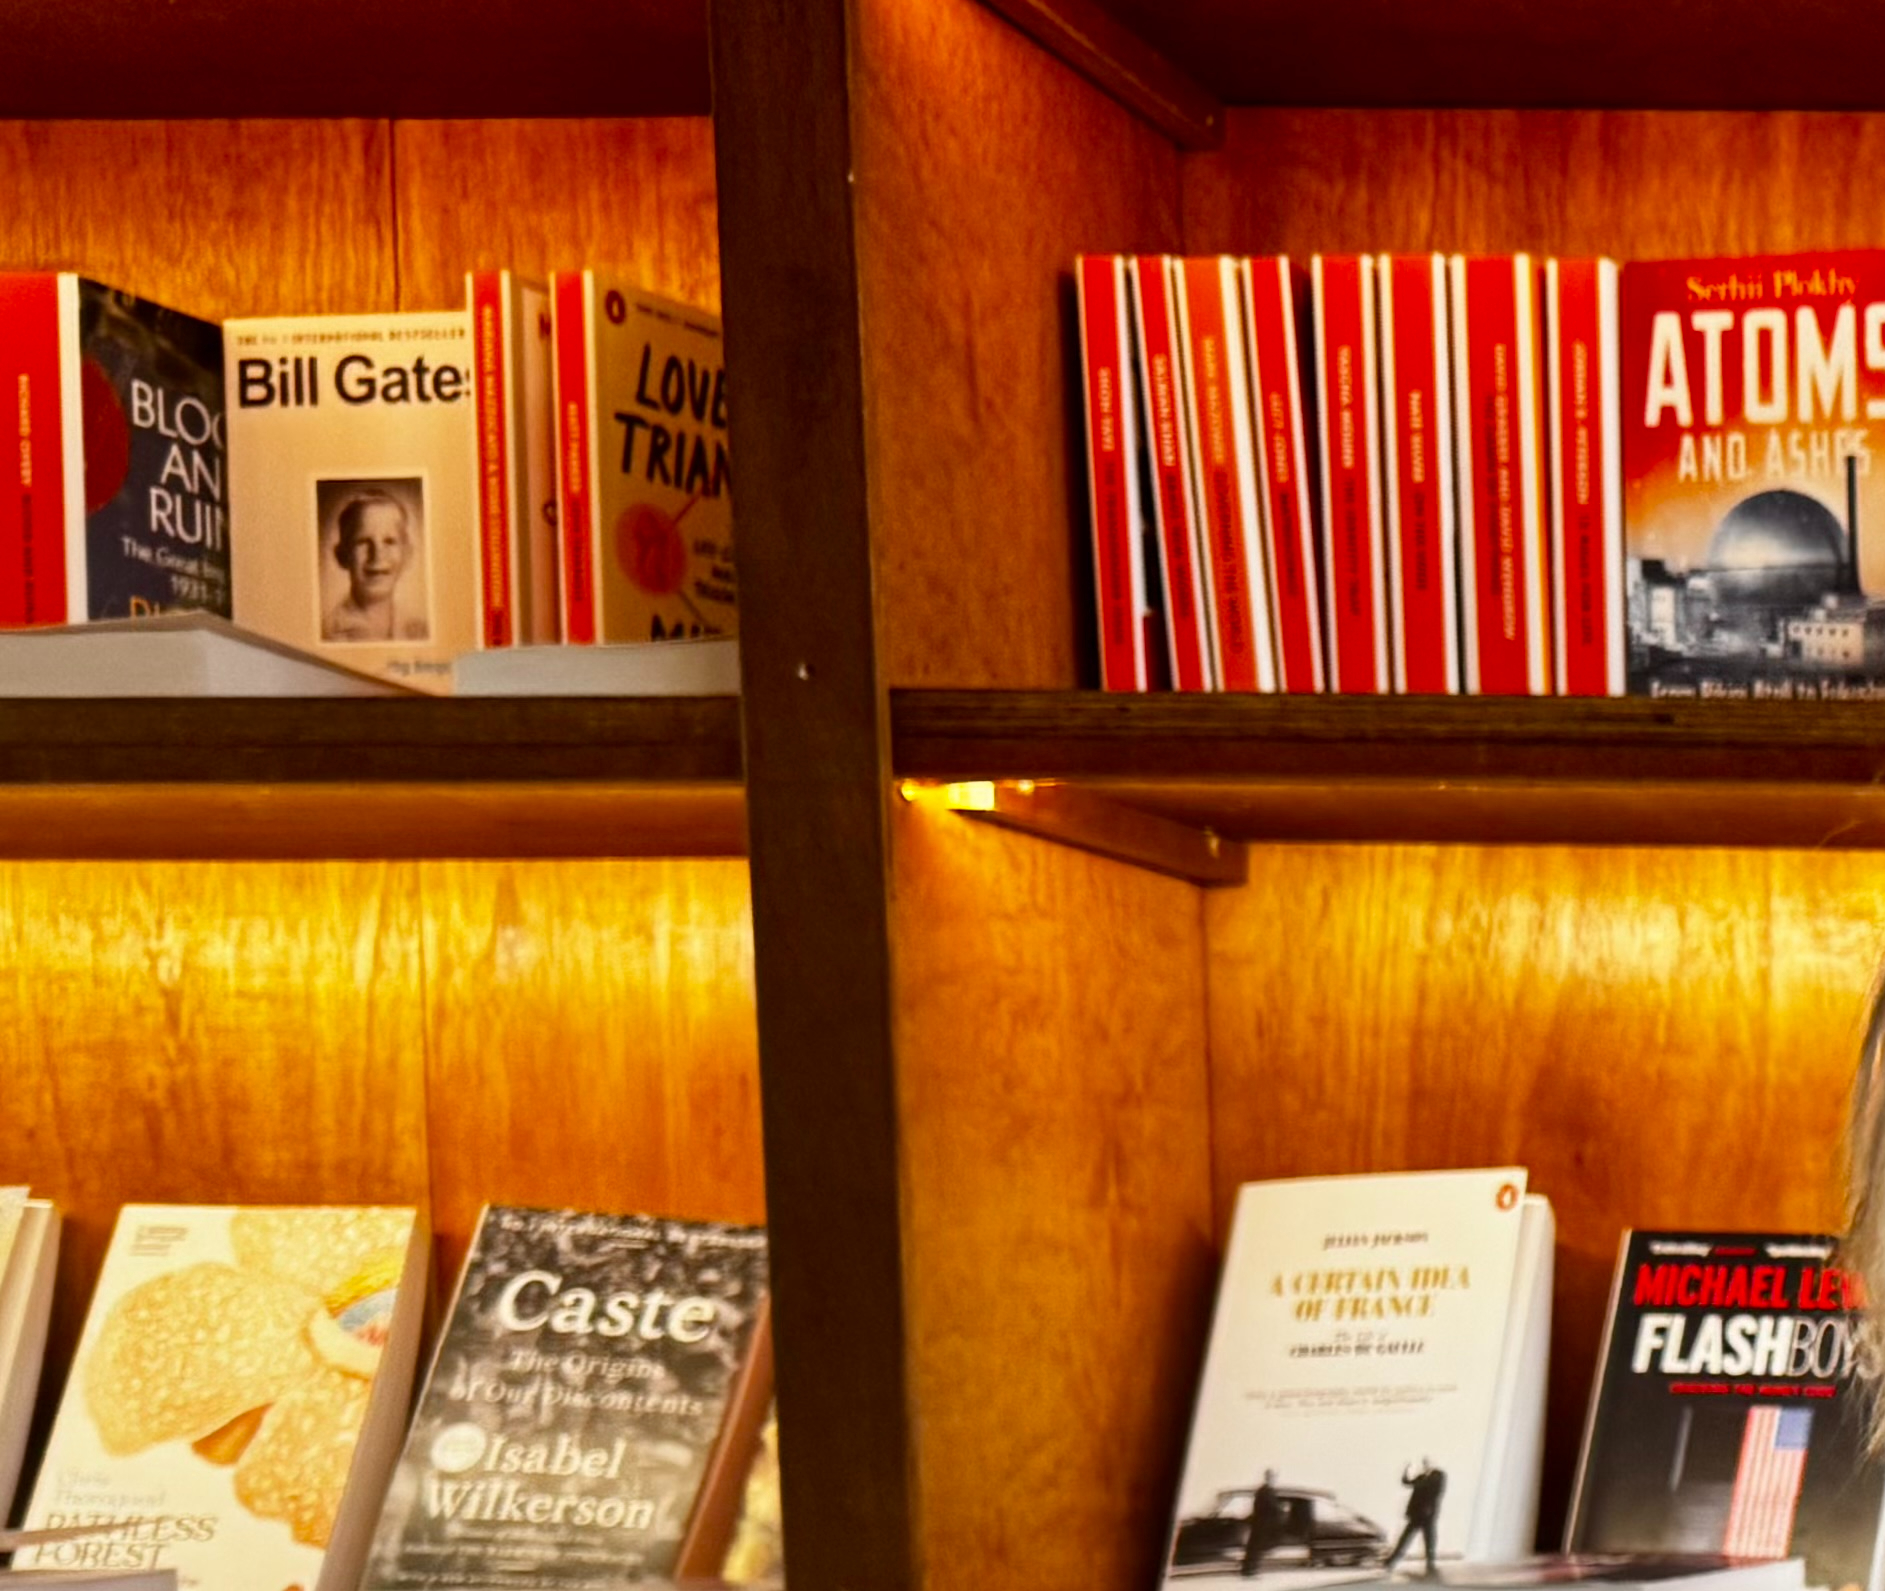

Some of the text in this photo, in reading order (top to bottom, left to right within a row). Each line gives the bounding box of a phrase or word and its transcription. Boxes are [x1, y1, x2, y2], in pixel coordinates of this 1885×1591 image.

[238, 356, 319, 408] Bill
[160, 443, 222, 501] AN
[614, 411, 731, 498] TRIAN
[1677, 431, 1748, 484] AND
[499, 1269, 718, 1343] Caste
[1633, 1262, 1870, 1312] MICHAEL LEW
[510, 1350, 667, 1382] The Origins
[483, 1433, 627, 1479] Isabel
[425, 1473, 657, 1530] Wilkerson
[35, 1541, 168, 1570] FOREST
